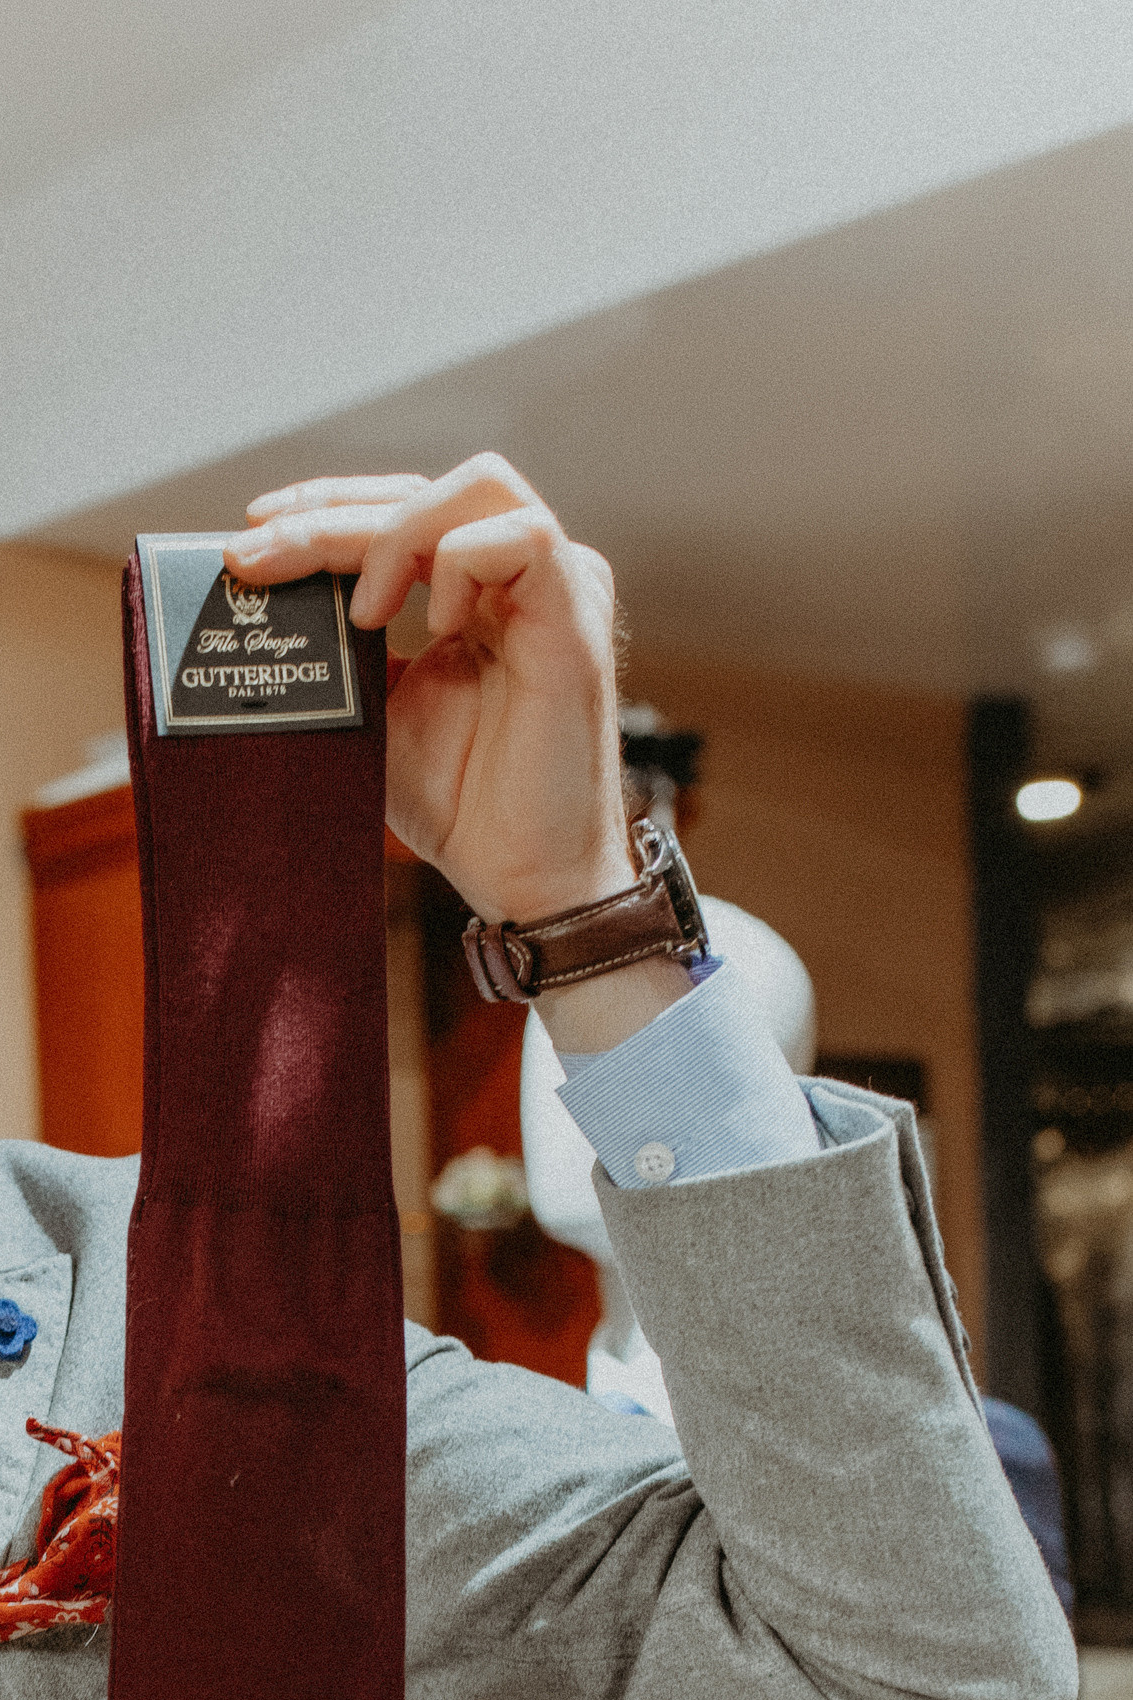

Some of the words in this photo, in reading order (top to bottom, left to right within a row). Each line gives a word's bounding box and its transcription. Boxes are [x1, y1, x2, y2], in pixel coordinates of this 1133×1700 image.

[197, 628, 240, 654] Filo
[244, 626, 309, 659] Scozia
[181, 662, 330, 688] GUTTERIDGE
[228, 686, 255, 698] DAL
